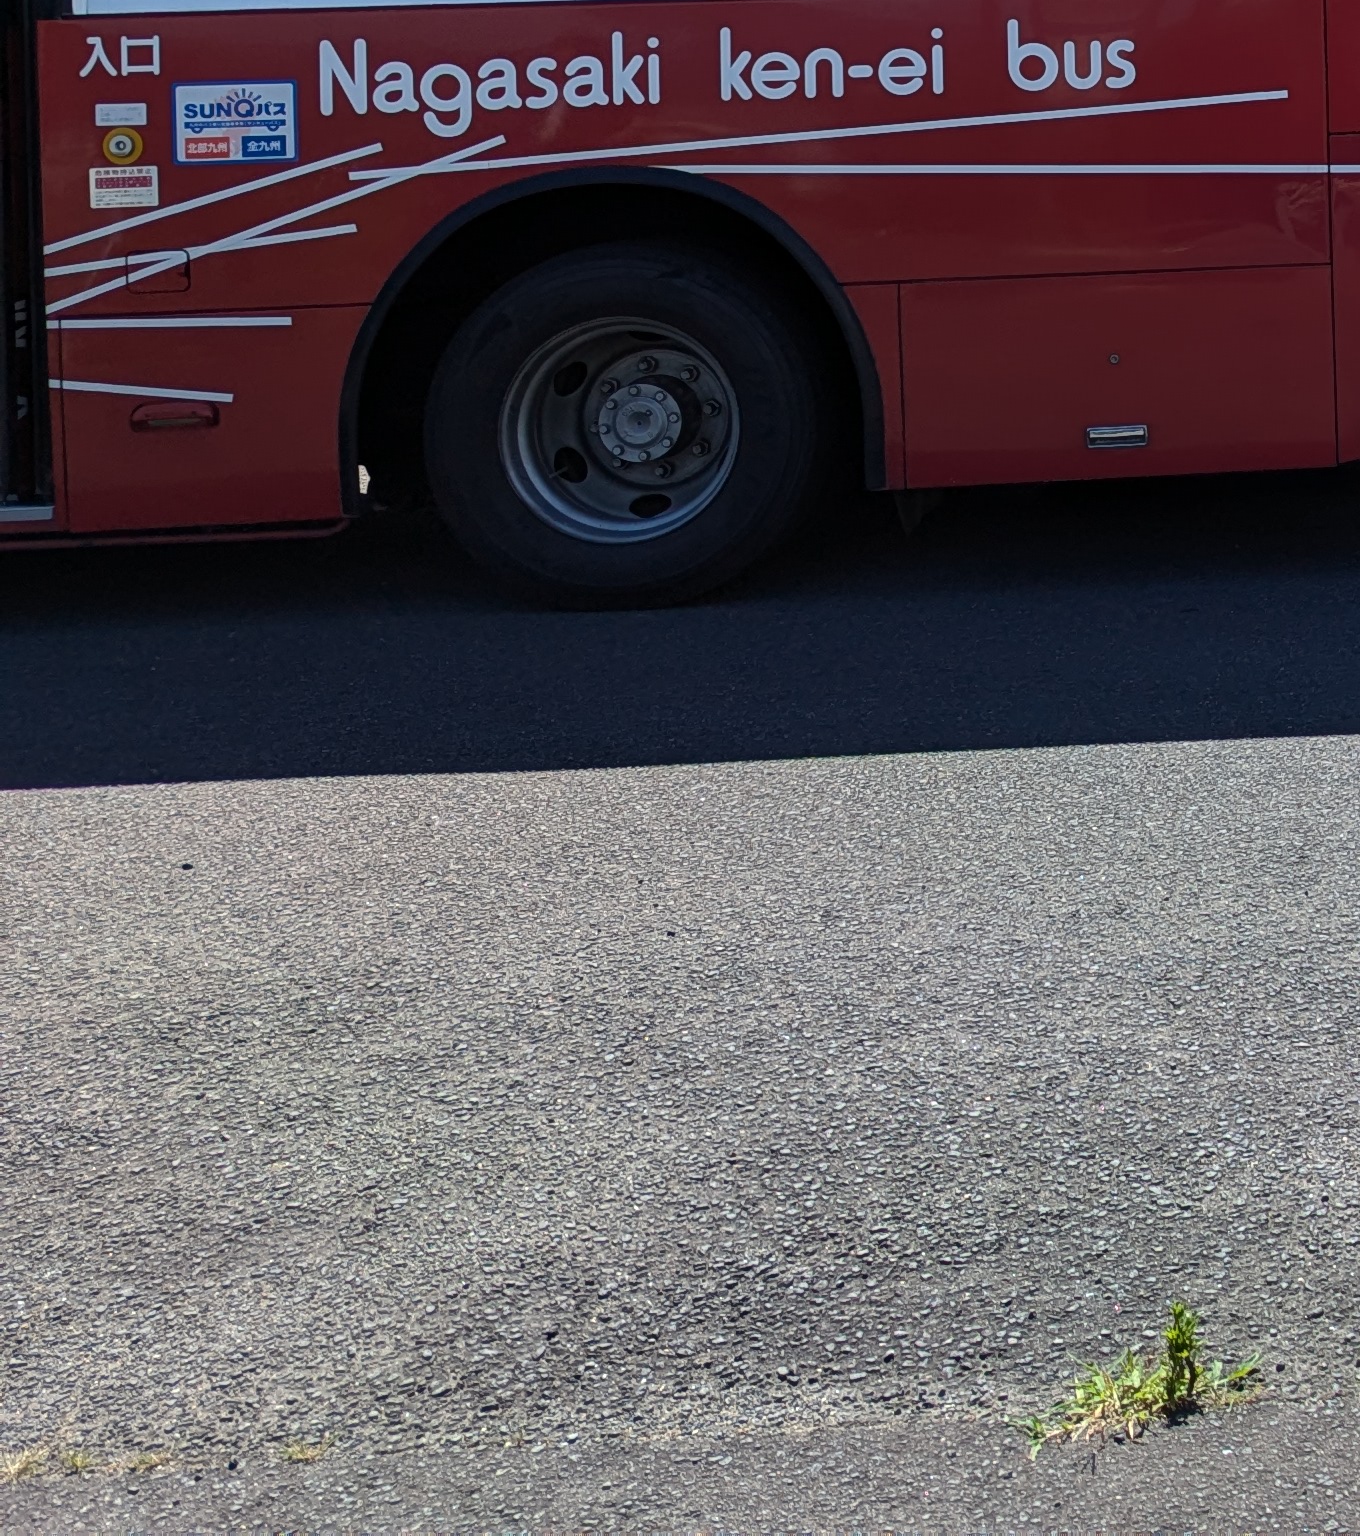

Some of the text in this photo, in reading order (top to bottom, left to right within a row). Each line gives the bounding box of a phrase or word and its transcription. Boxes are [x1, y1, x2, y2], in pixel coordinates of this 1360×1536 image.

[79, 35, 160, 77] 入口
[319, 19, 1137, 137] Nagasaki ken-ei bus
[184, 98, 286, 119] SUNQパス
[187, 142, 228, 154] 北部九州
[247, 140, 281, 152] 全九州
